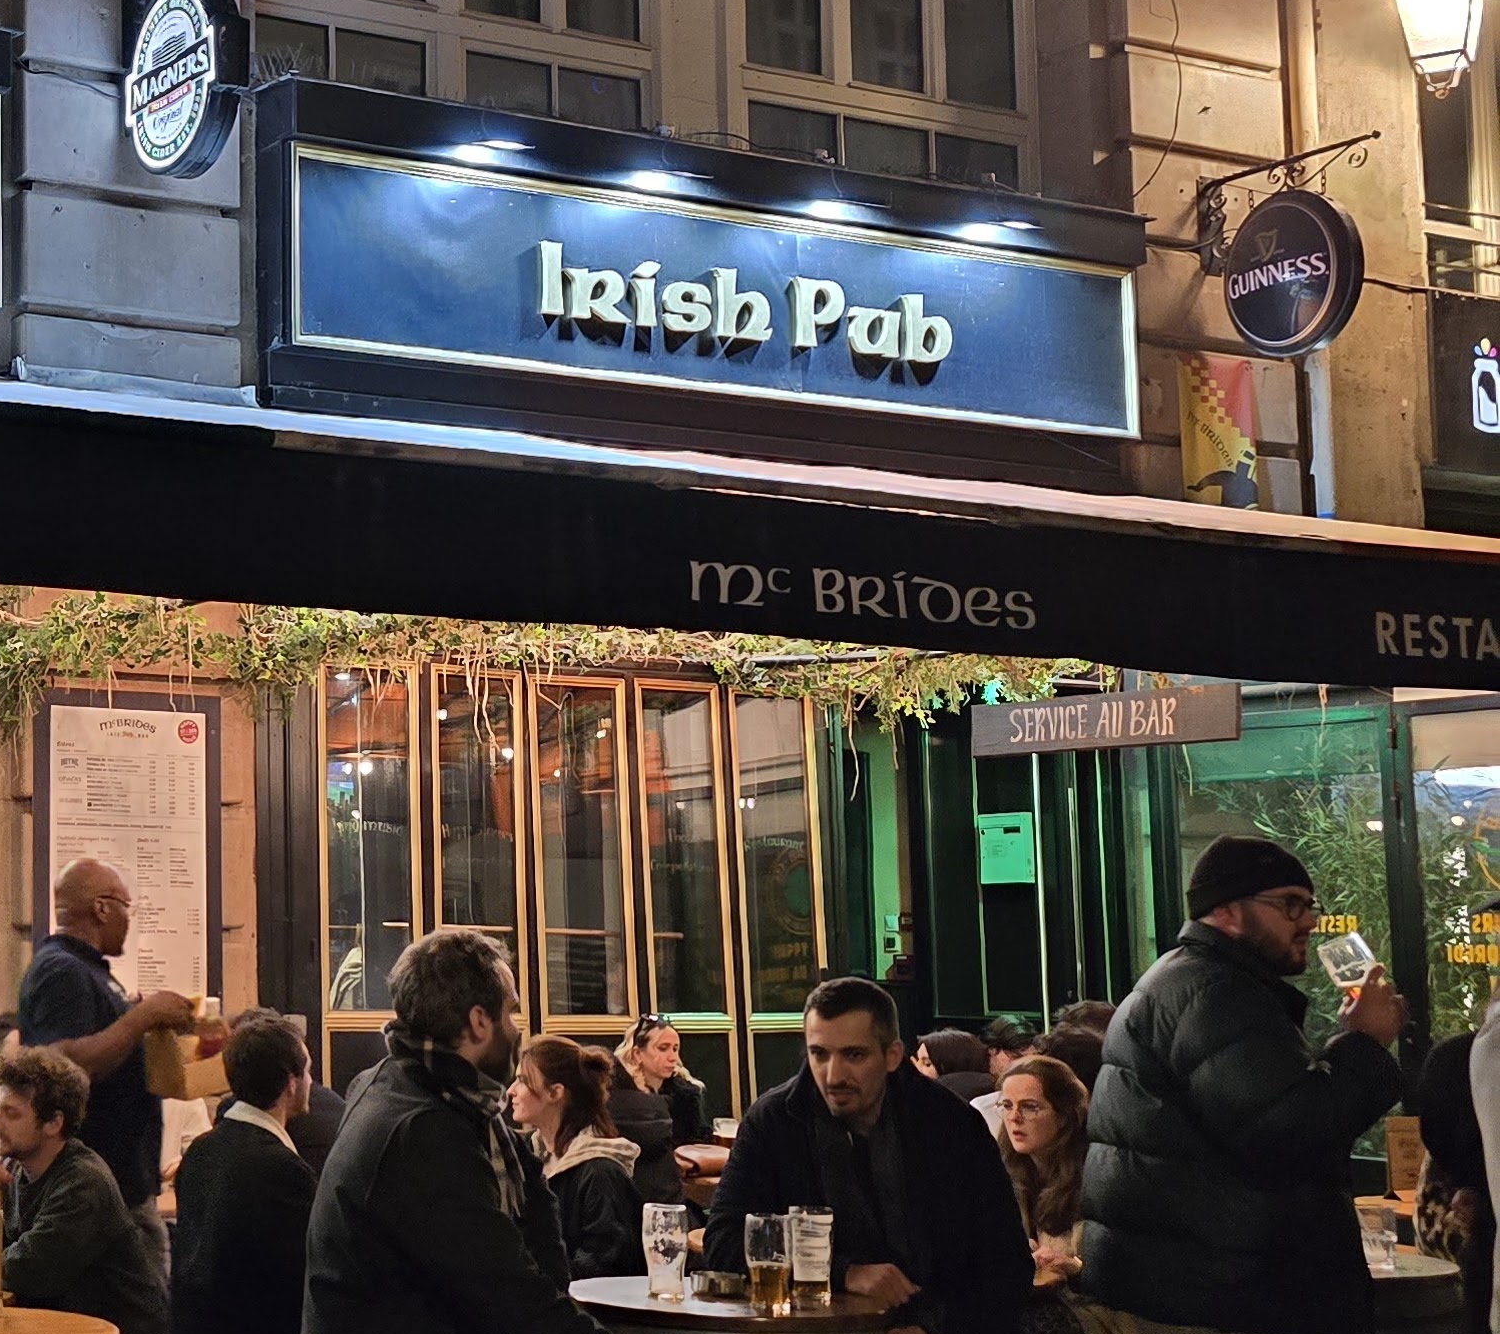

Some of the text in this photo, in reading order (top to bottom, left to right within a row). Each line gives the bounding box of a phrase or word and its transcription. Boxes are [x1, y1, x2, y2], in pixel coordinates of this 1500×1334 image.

[131, 43, 210, 112] MAGNERS
[539, 239, 954, 364] Irish Pub
[1228, 252, 1330, 301] GUINNESS
[1009, 697, 1178, 744] SERVICE AU BAR
